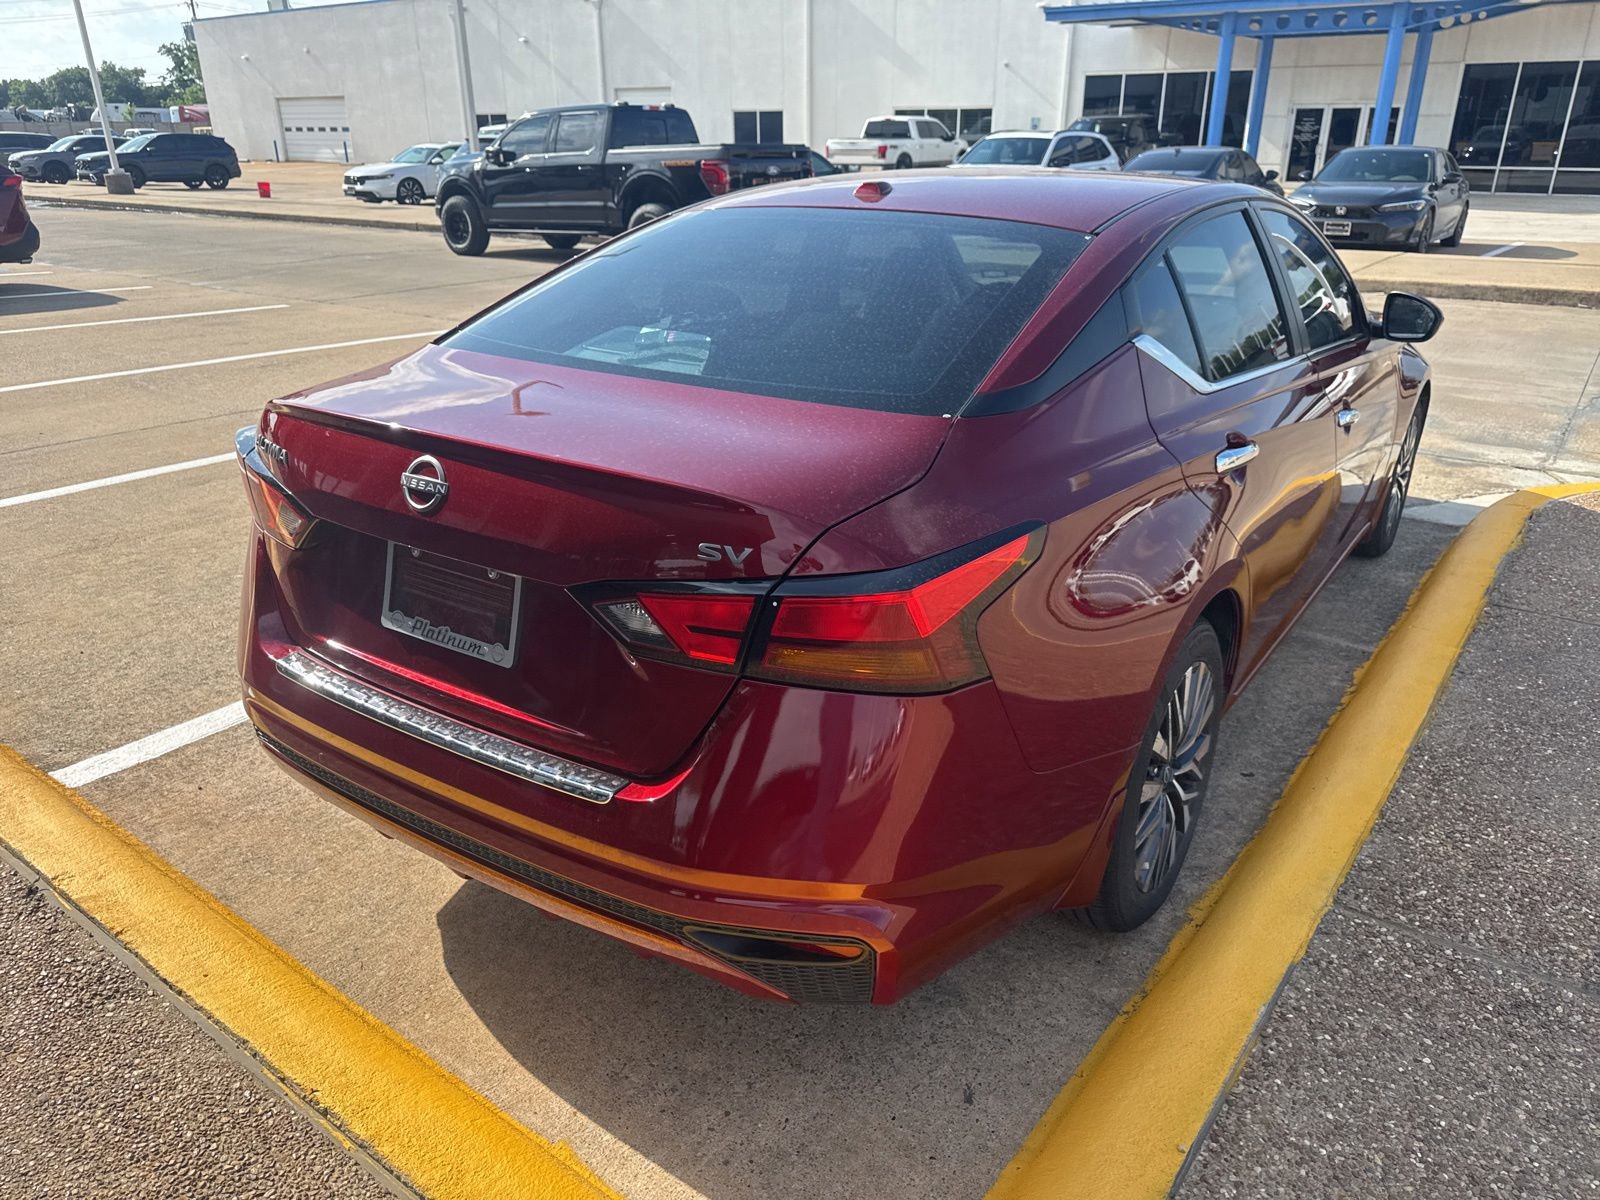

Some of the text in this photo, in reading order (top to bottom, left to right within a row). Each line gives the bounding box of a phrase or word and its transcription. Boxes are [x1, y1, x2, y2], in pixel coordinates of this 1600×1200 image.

[401, 474, 446, 494] NISSAN
[697, 542, 753, 566] SV
[411, 619, 485, 657] Platinum
